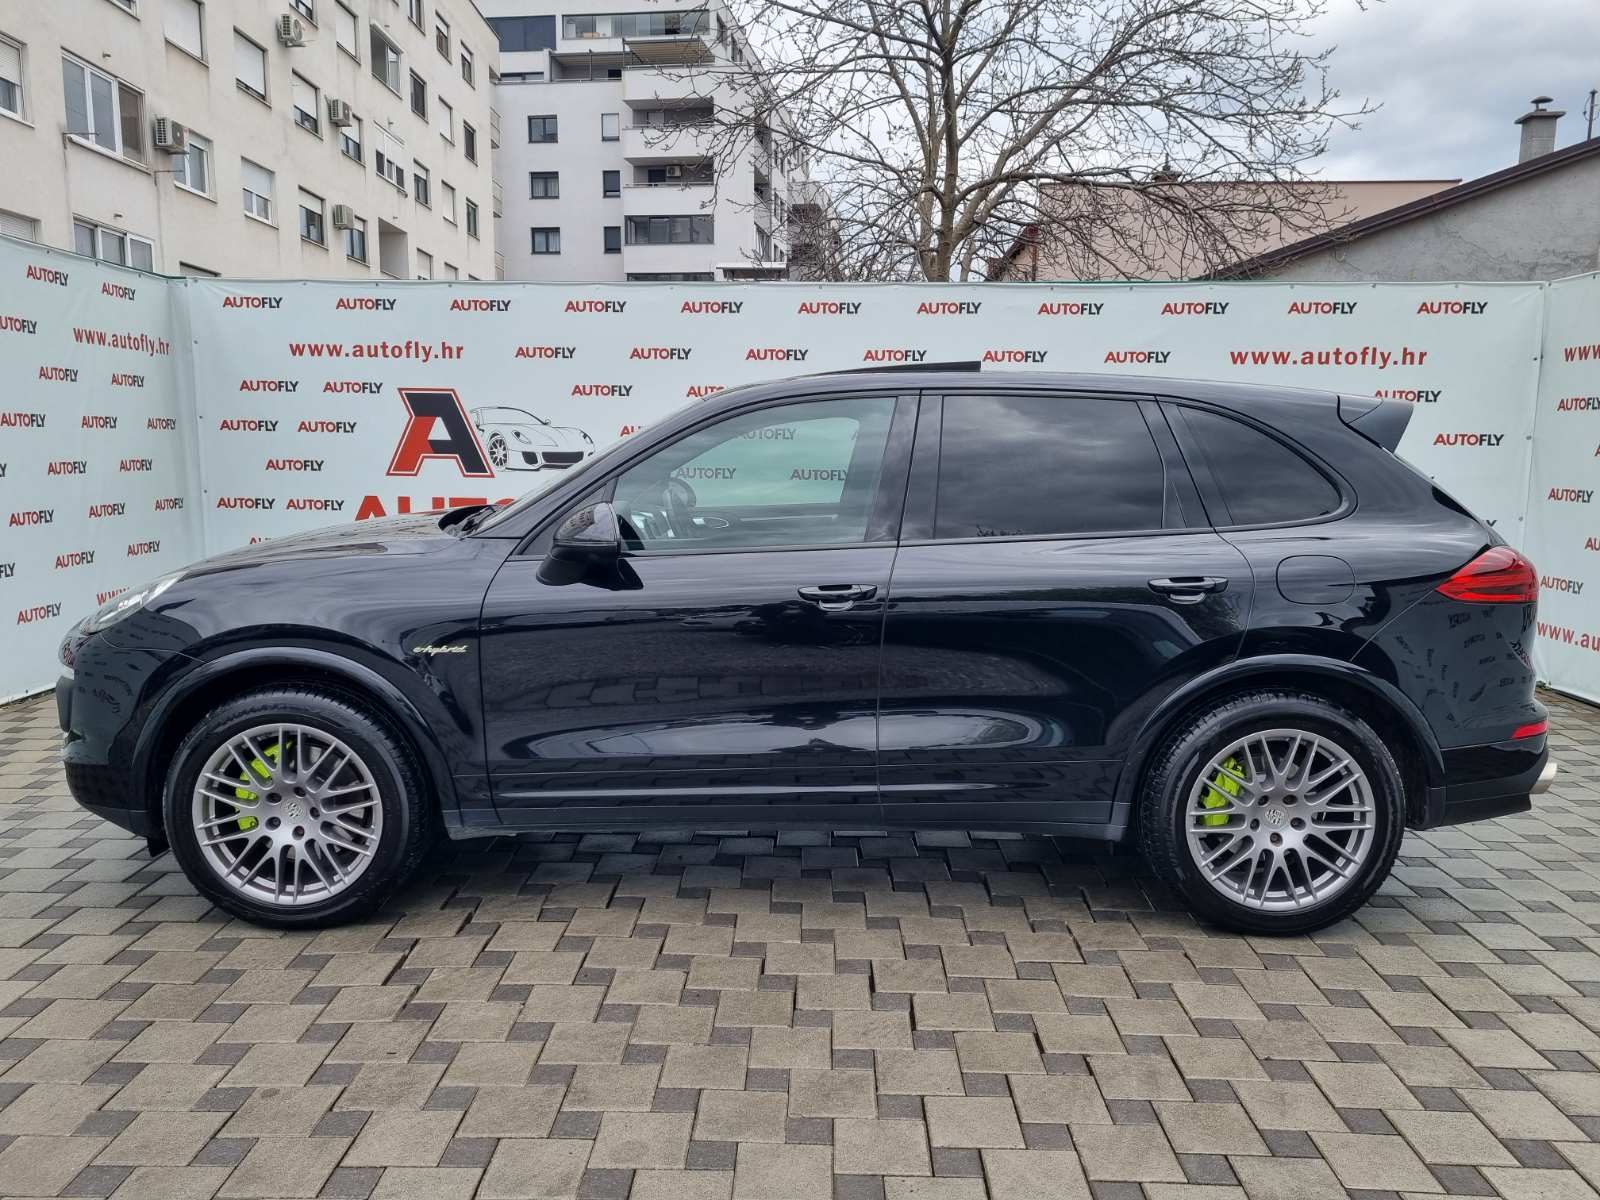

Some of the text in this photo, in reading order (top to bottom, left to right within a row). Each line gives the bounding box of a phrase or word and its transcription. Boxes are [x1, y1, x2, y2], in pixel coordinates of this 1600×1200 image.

[27, 265, 69, 286] AUTOFLY
[102, 282, 136, 301] AUTOFLY
[222, 296, 283, 309] AUTOFLY
[335, 297, 397, 311] AUTOFLY
[450, 299, 511, 312] AUTOFLY
[565, 300, 627, 313] AUTOFLY
[681, 301, 743, 314] AUTOFLY
[798, 301, 862, 315] AUTOFLY
[917, 301, 982, 315] AUTOFLY
[1037, 302, 1104, 316] AUTOFLY
[1162, 301, 1229, 315] AUTOFLY
[1288, 301, 1357, 315] AUTOFLY
[1417, 301, 1488, 315] AUTOFLY
[0, 315, 38, 334] UTOFLY
[73, 327, 170, 357] www.autofly.hr
[288, 340, 464, 364] www.autofly.hr
[514, 346, 577, 359] AUTOFLY
[629, 347, 692, 360] AUTOFLY
[745, 348, 809, 361] AUTOFLY
[863, 349, 927, 362] AUTOFLY
[982, 350, 1048, 363] AUTOFLY
[1104, 351, 1170, 364] AUTOFLY
[1230, 346, 1428, 370] www.autofly.hr
[38, 366, 79, 382] AUTOFLY
[111, 373, 145, 388] AUTOFLY
[239, 380, 299, 393] AUTOFLY
[323, 382, 383, 394] AUTOFLY
[571, 384, 633, 397] AUTOFLY
[0, 412, 46, 427] AUTOFLY
[81, 416, 118, 429] AUTOFLY
[147, 418, 177, 431] AUTOFLY
[219, 419, 279, 432] AUTOFLY
[297, 421, 357, 433] AUTOFLY
[1432, 433, 1504, 447] AUTOFLY
[47, 461, 87, 475] AUTOFLY
[119, 459, 153, 472] AUTOFLY
[265, 459, 325, 472] AUTOFLY
[677, 467, 737, 480] AUTOFLY
[1547, 487, 1594, 504] AUTOFLY
[88, 502, 126, 518] AUTOFLY
[154, 497, 185, 511] AUTOFLY
[216, 497, 276, 510] AUTOFLY
[286, 499, 345, 512] AUTOFLY
[9, 509, 55, 527] AUTOFLY
[127, 540, 161, 557] AUTOFLY
[55, 550, 95, 569] AUTOFLY
[1540, 575, 1584, 595] AUTOFLY
[17, 602, 62, 625] AUTOFLY
